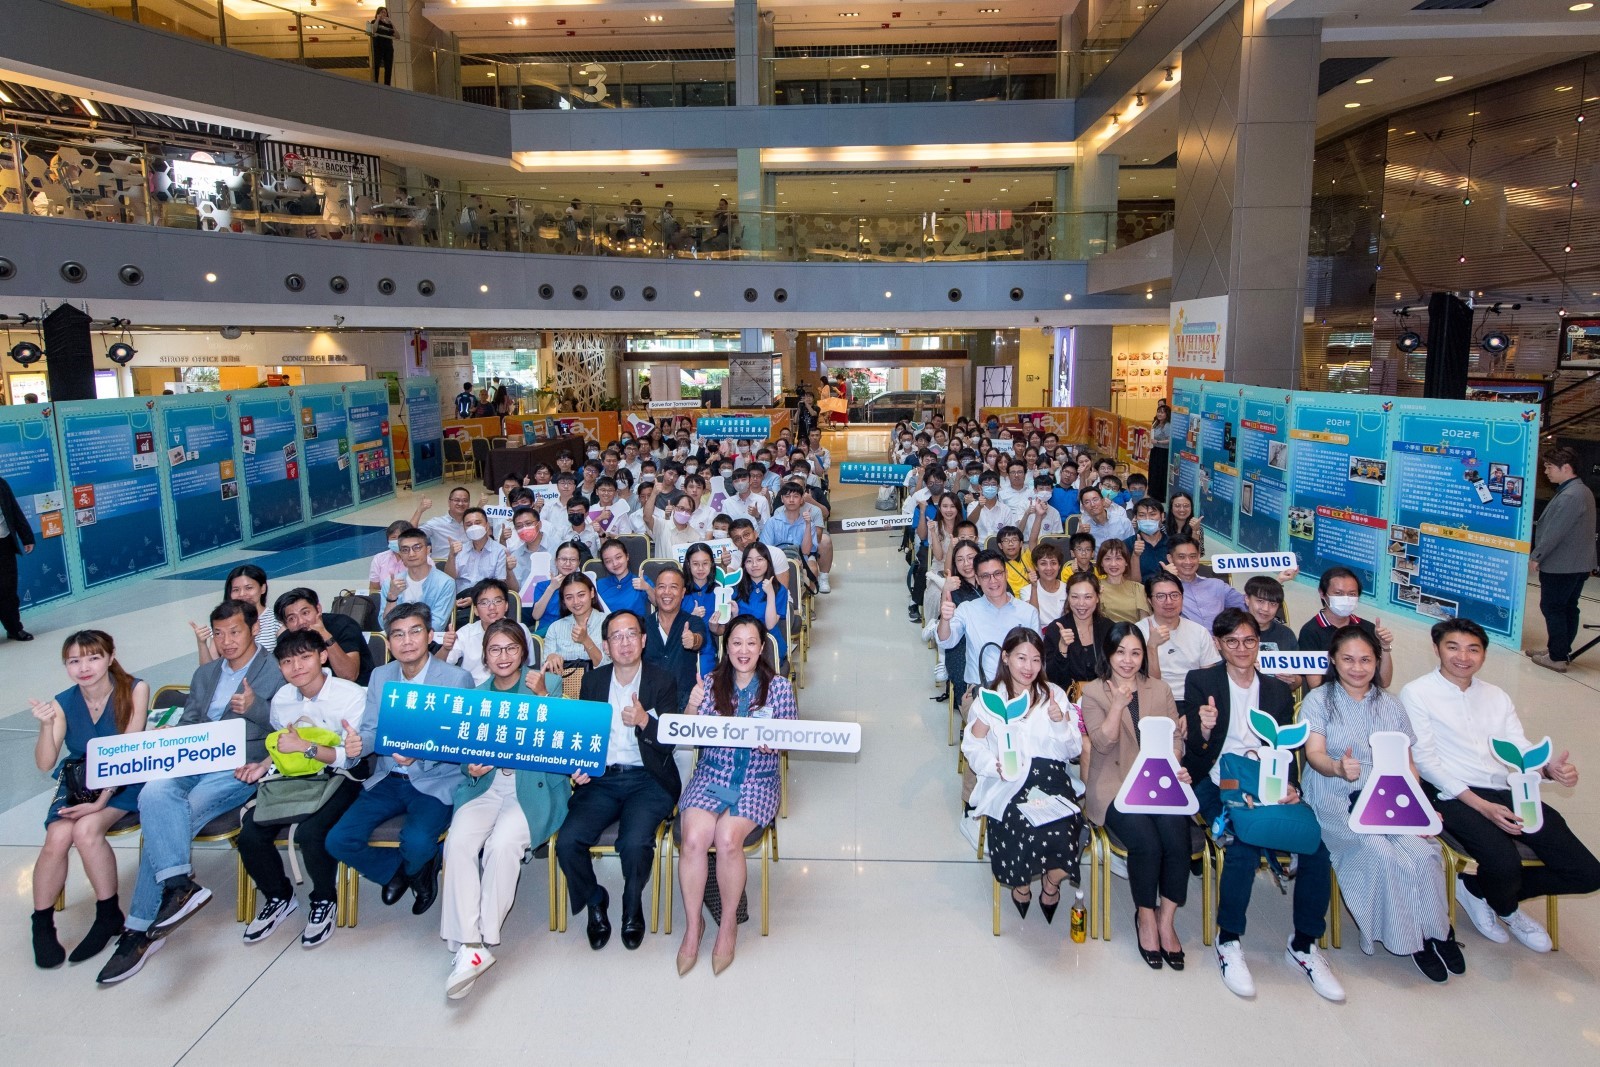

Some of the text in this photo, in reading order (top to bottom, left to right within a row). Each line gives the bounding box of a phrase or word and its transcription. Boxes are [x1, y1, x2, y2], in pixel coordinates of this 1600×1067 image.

[584, 63, 608, 102] 3
[1326, 418, 1351, 427] 2021年
[1441, 428, 1480, 439] 2022年
[486, 507, 513, 517] SAMS
[880, 517, 913, 525] Tomorro
[1217, 555, 1291, 569] SAMSUNG
[1261, 656, 1328, 669] MSUNG
[388, 688, 548, 723] 十載共「童」無窮想像
[97, 732, 209, 757] Together for Tomorrow!
[440, 720, 602, 753] 一起創造可持續未來
[668, 721, 851, 745] Solve for Tomorrow
[97, 742, 236, 777] Enabling People
[441, 744, 459, 754] that
[497, 750, 514, 760] our
[515, 750, 567, 765] Sustainable
[569, 757, 599, 769] Future
